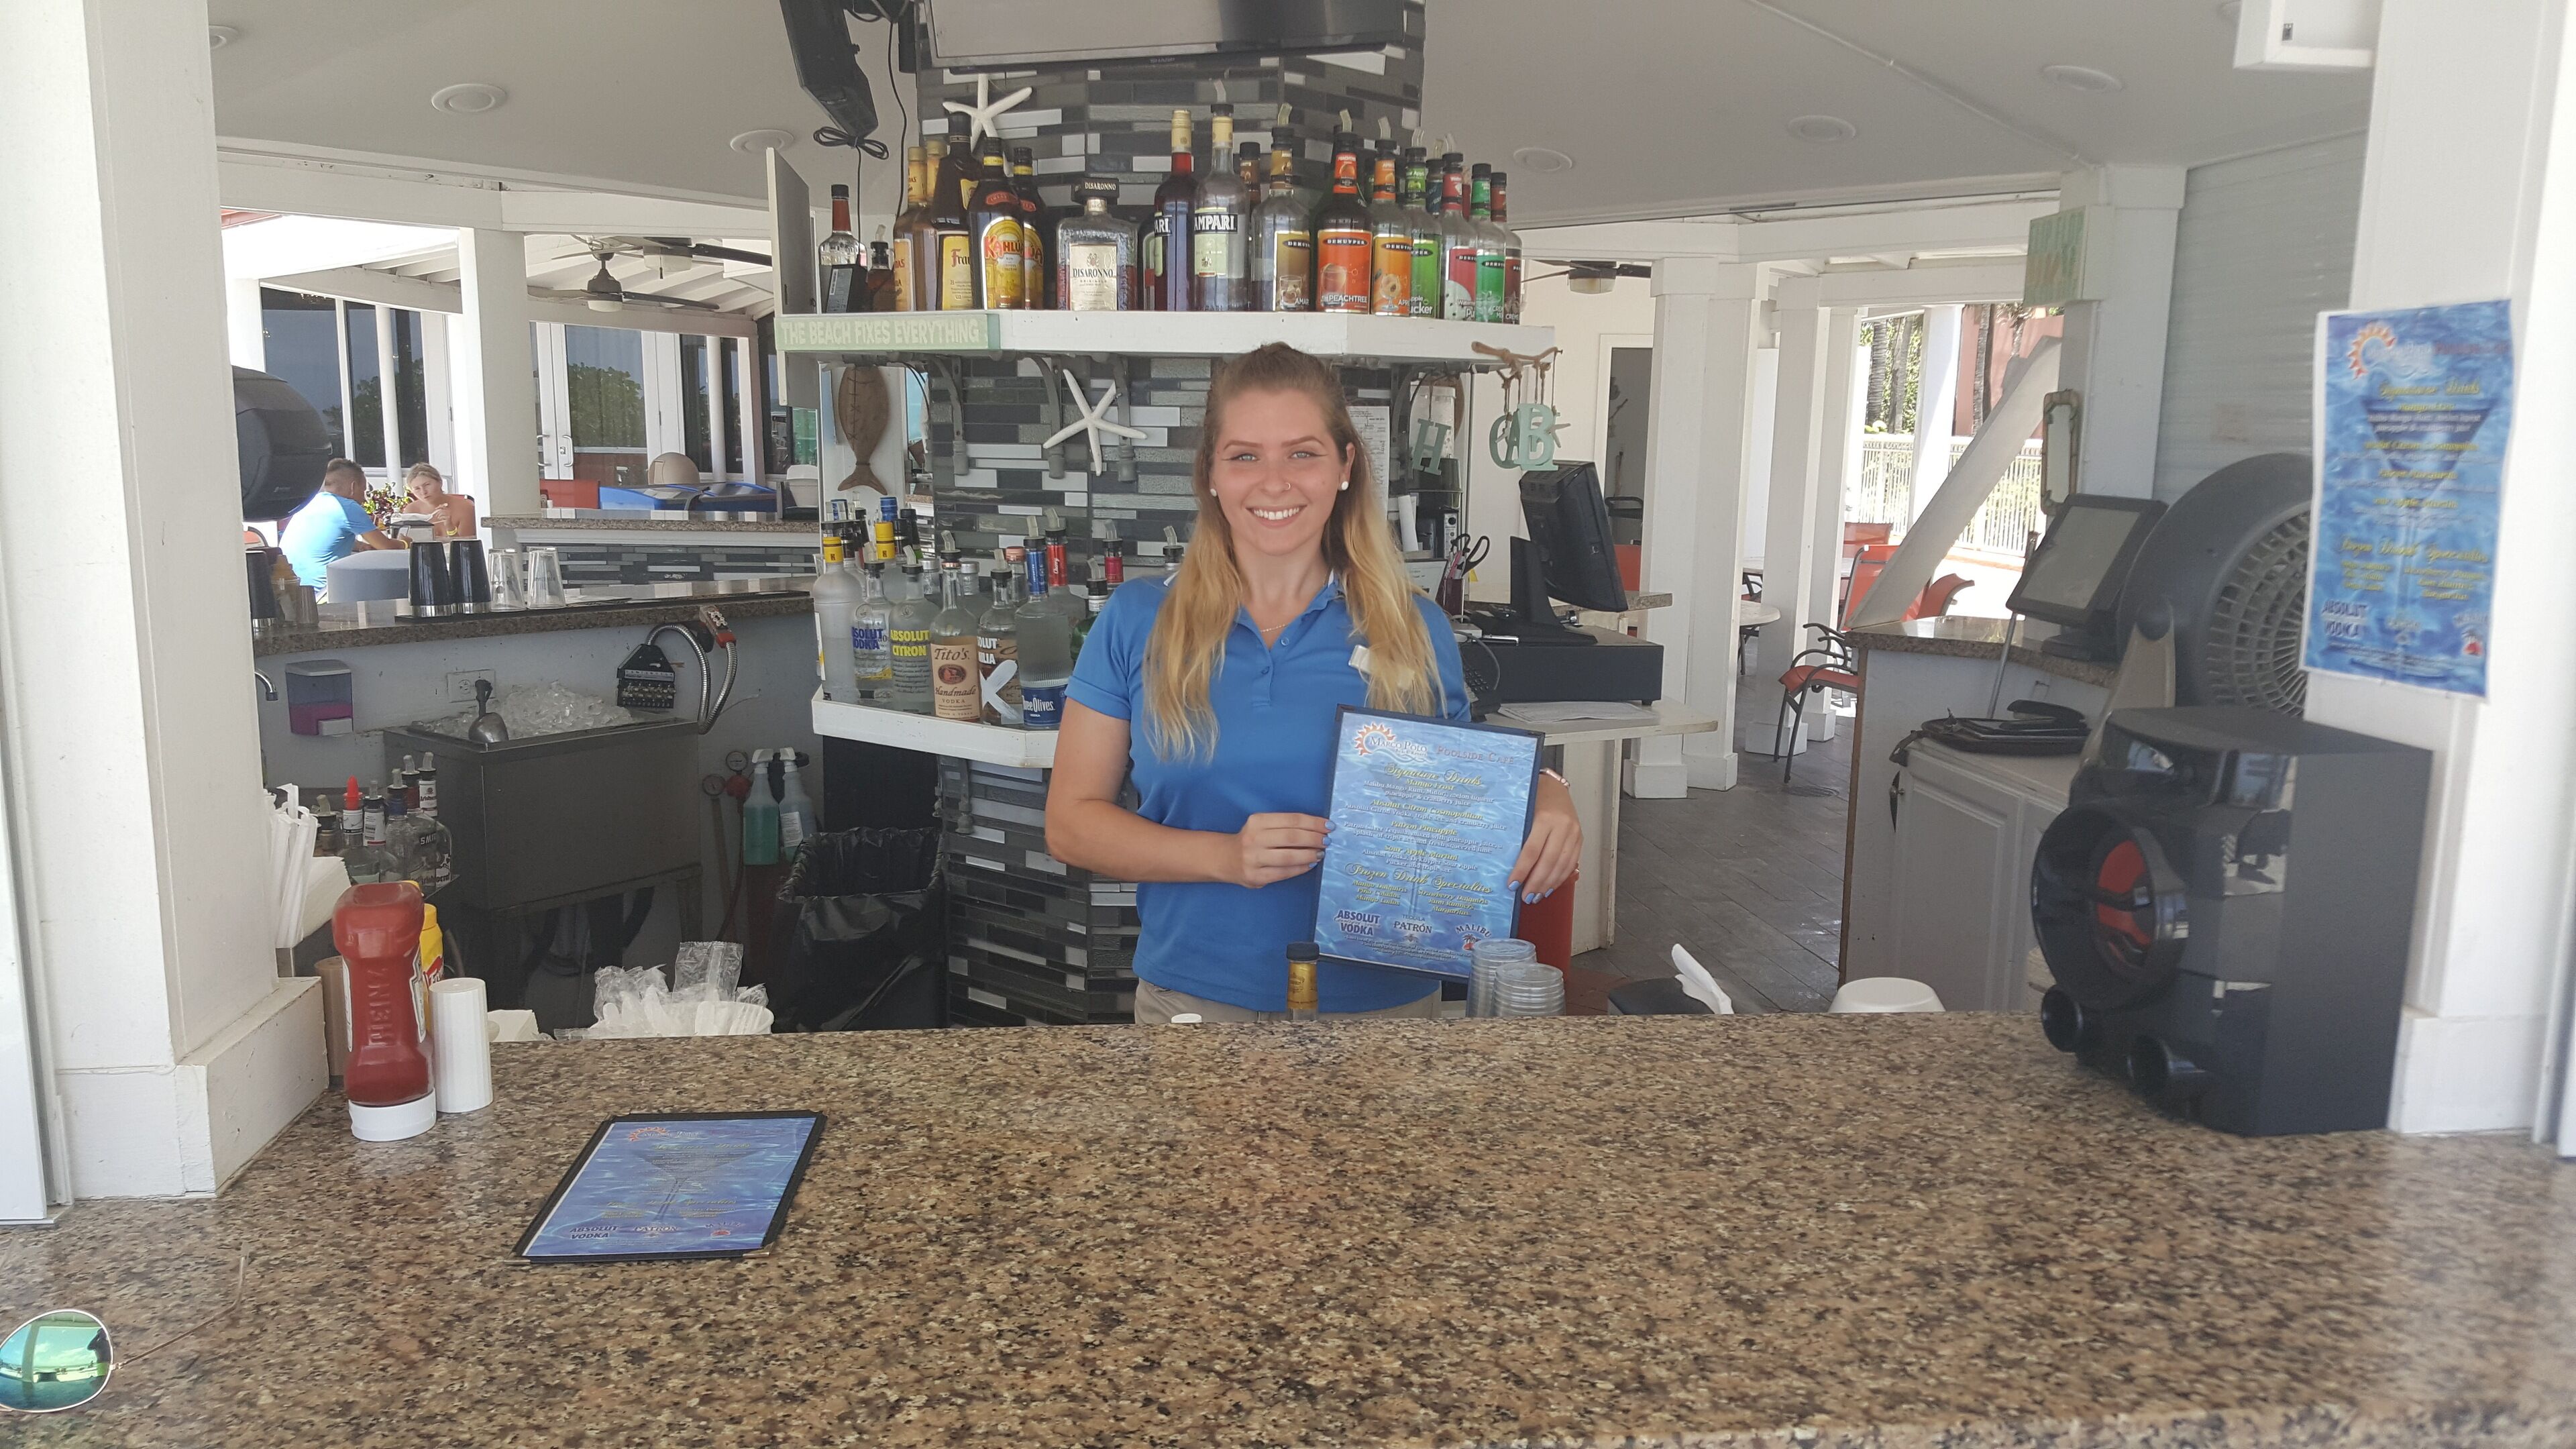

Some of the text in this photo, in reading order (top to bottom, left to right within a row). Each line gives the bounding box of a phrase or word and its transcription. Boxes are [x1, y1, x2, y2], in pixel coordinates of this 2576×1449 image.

[1084, 182, 1116, 191] DISARONNO
[1193, 214, 1235, 231] AMPARI
[1073, 268, 1114, 278] DISARONNO
[1329, 294, 1368, 304] PEACHTREE
[1411, 295, 1424, 304] pple
[781, 319, 979, 345] THE BEACH FIXES EVERYTHING
[891, 629, 930, 642] ABSOLUT
[853, 638, 880, 650] ODKA
[892, 645, 927, 657] CITRON
[934, 684, 977, 697] Handmade
[1370, 736, 1428, 751] MARCO POLO
[1437, 745, 1483, 760] POOLSIDE
[1384, 763, 1484, 786] Signature Drinks
[1386, 783, 1407, 792] Mango
[1406, 778, 1455, 791] Mango Frost
[1385, 790, 1415, 800] pineapple
[1424, 795, 1454, 805] cranberry
[1371, 799, 1483, 820] Absolut Citron Cosmopolitan
[1419, 824, 1458, 836] Pineapple
[1458, 817, 1489, 829] cranberry
[1490, 822, 1507, 831] juice
[1353, 829, 1375, 839] splash
[1428, 839, 1446, 847] fresh
[1446, 843, 1477, 853] squeezed
[1448, 835, 1479, 846] pineapple
[1385, 845, 1458, 861] Sour Apple Martini
[1386, 859, 1409, 868] Pucker
[1344, 863, 1493, 894] Frozen Drink Specialties
[1352, 879, 1375, 889] Mango
[1417, 889, 1456, 902] Strawberry
[1428, 898, 1475, 910] Rum Runners
[1338, 910, 1381, 924] ABSOLUT
[1432, 906, 1472, 917] Margaritas
[1341, 922, 1374, 936] VODKA
[1393, 920, 1433, 934] PATRÓN
[1455, 924, 1492, 938] MALIBU
[569, 1224, 619, 1233] ABSOLUT
